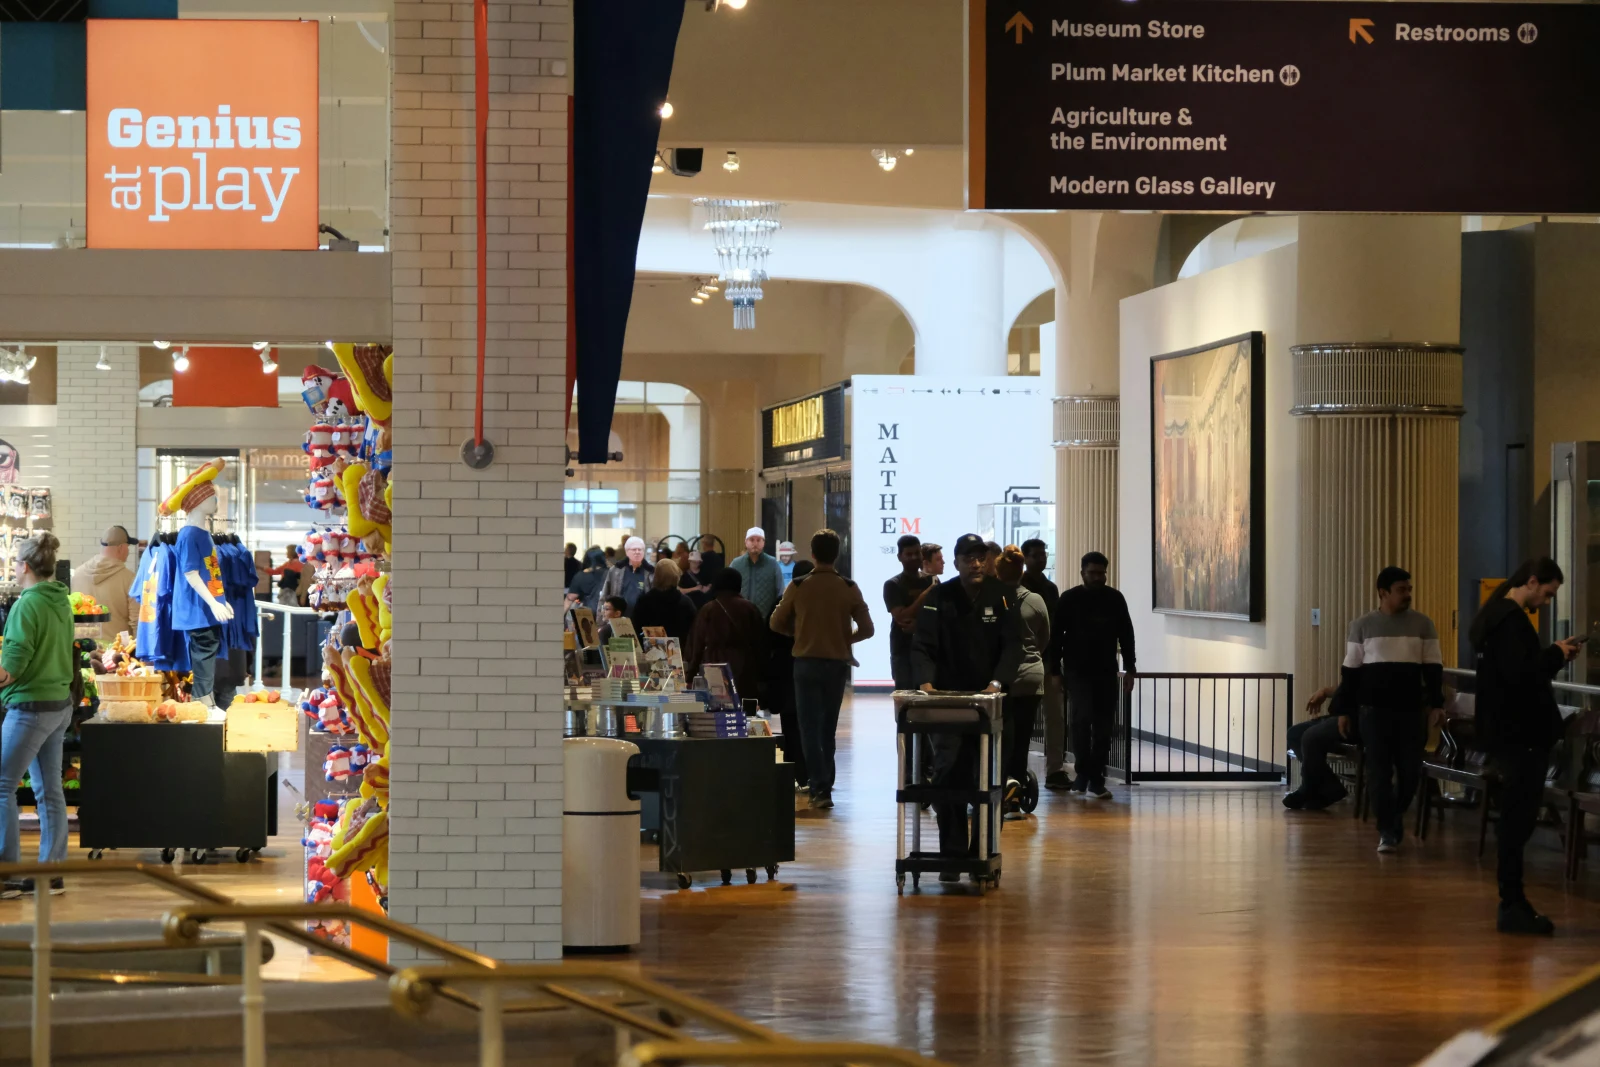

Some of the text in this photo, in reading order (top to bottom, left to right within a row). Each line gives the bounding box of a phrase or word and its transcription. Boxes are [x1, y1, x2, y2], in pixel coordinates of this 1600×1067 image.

[1051, 20, 1206, 39] Museum Store
[1395, 23, 1511, 42] Restrooms
[1051, 63, 1275, 83] Plum Market Kitchen
[107, 104, 302, 149] Genius
[1050, 107, 1193, 129] Agriculture &
[1050, 132, 1228, 151] the Environment
[104, 165, 142, 210] at
[148, 152, 300, 222] play
[1050, 176, 1277, 200] Modern Glass Gallery
[661, 774, 680, 872] JUNK
